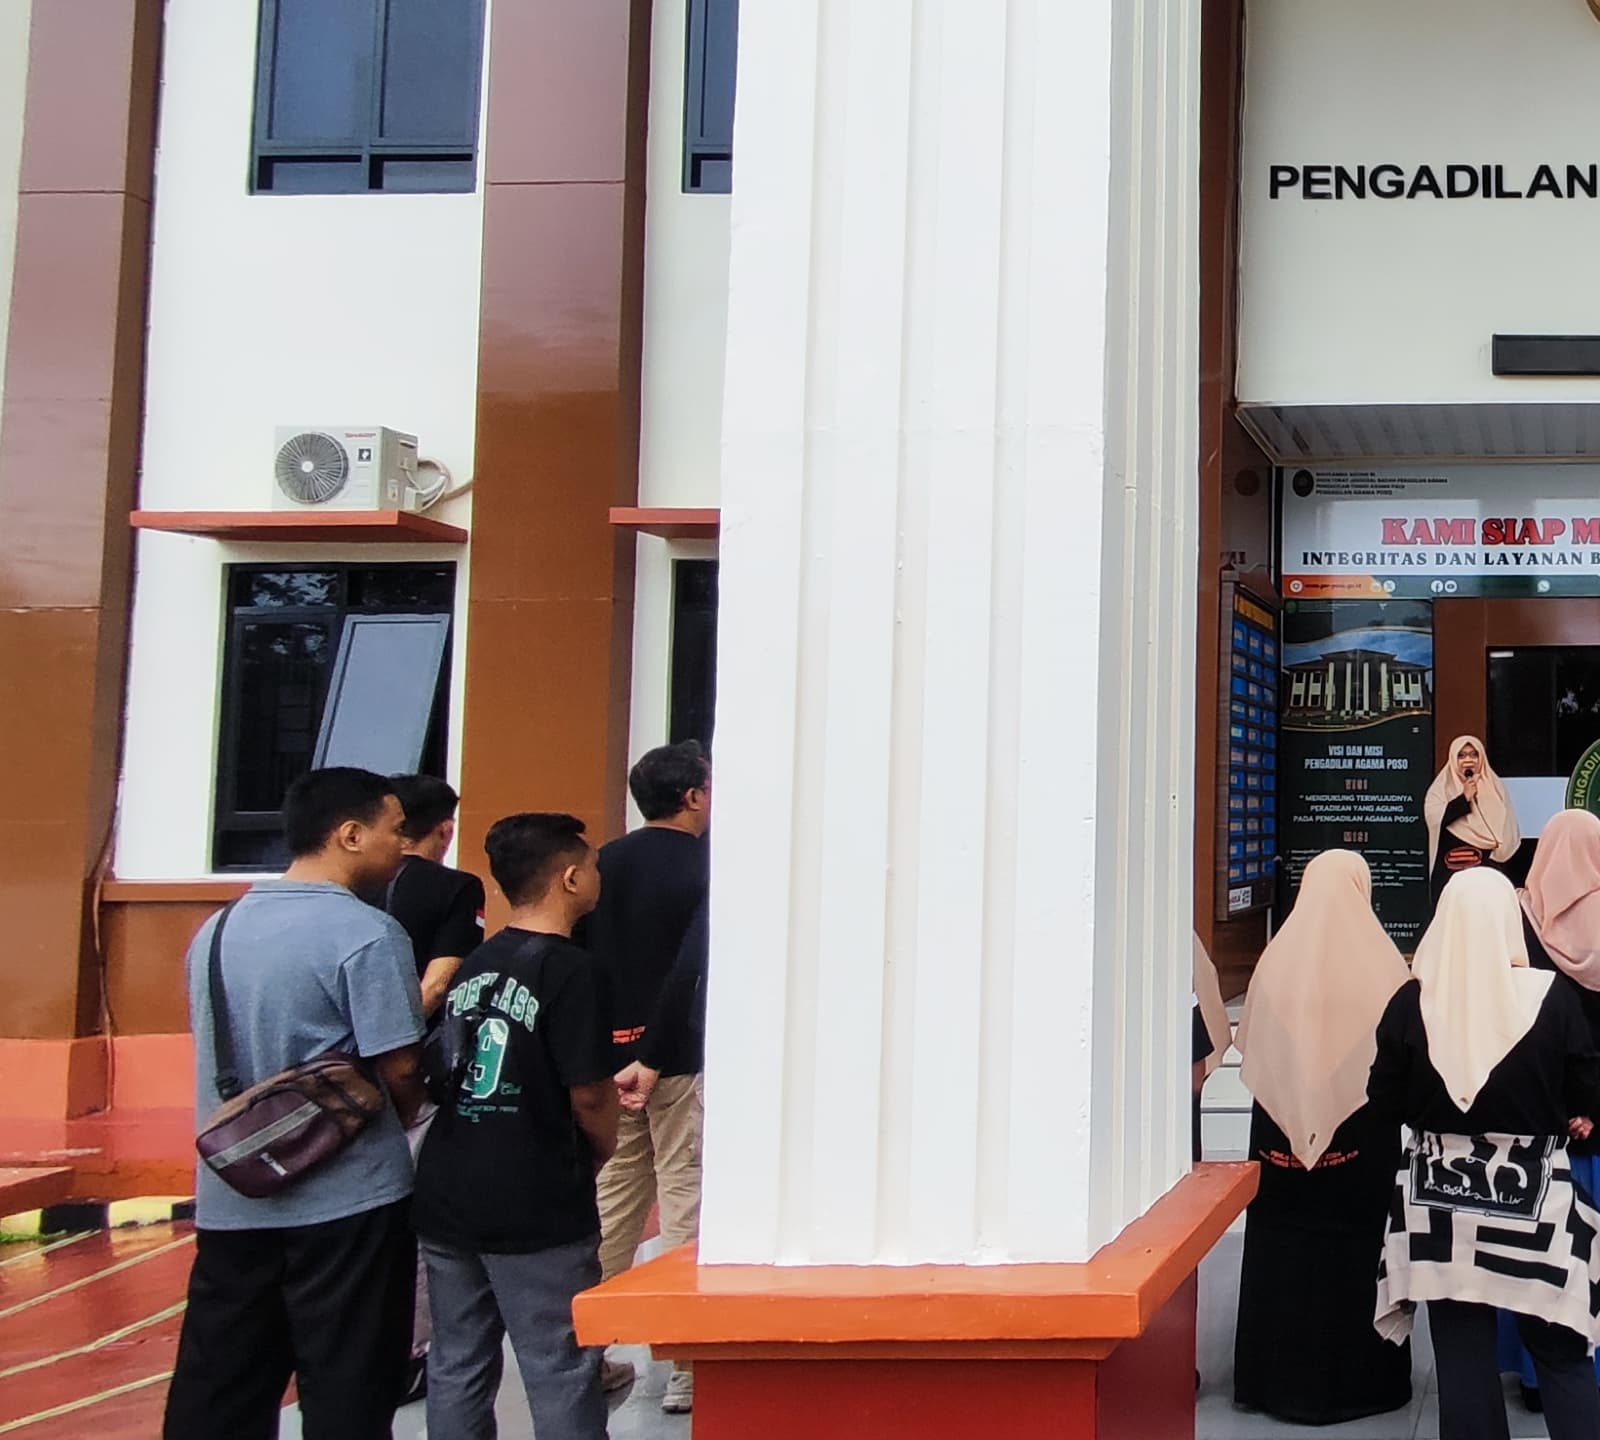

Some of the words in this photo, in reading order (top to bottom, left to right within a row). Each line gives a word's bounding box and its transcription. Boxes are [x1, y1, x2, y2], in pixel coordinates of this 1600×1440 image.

[1269, 164, 1599, 200] PENGADILAN
[1381, 518, 1476, 545] KAMI
[1481, 517, 1566, 545] SIAP
[1302, 552, 1428, 565] INTEGRITAS
[1435, 552, 1477, 565] DAN
[1484, 552, 1583, 565] LAYANAN
[1328, 745, 1344, 756] VISI
[1345, 745, 1363, 756] DAN
[1364, 745, 1384, 756] MISI
[1304, 758, 1353, 770] PENGADILAN
[1354, 758, 1385, 770] AGAMA
[1386, 758, 1408, 770] POSO
